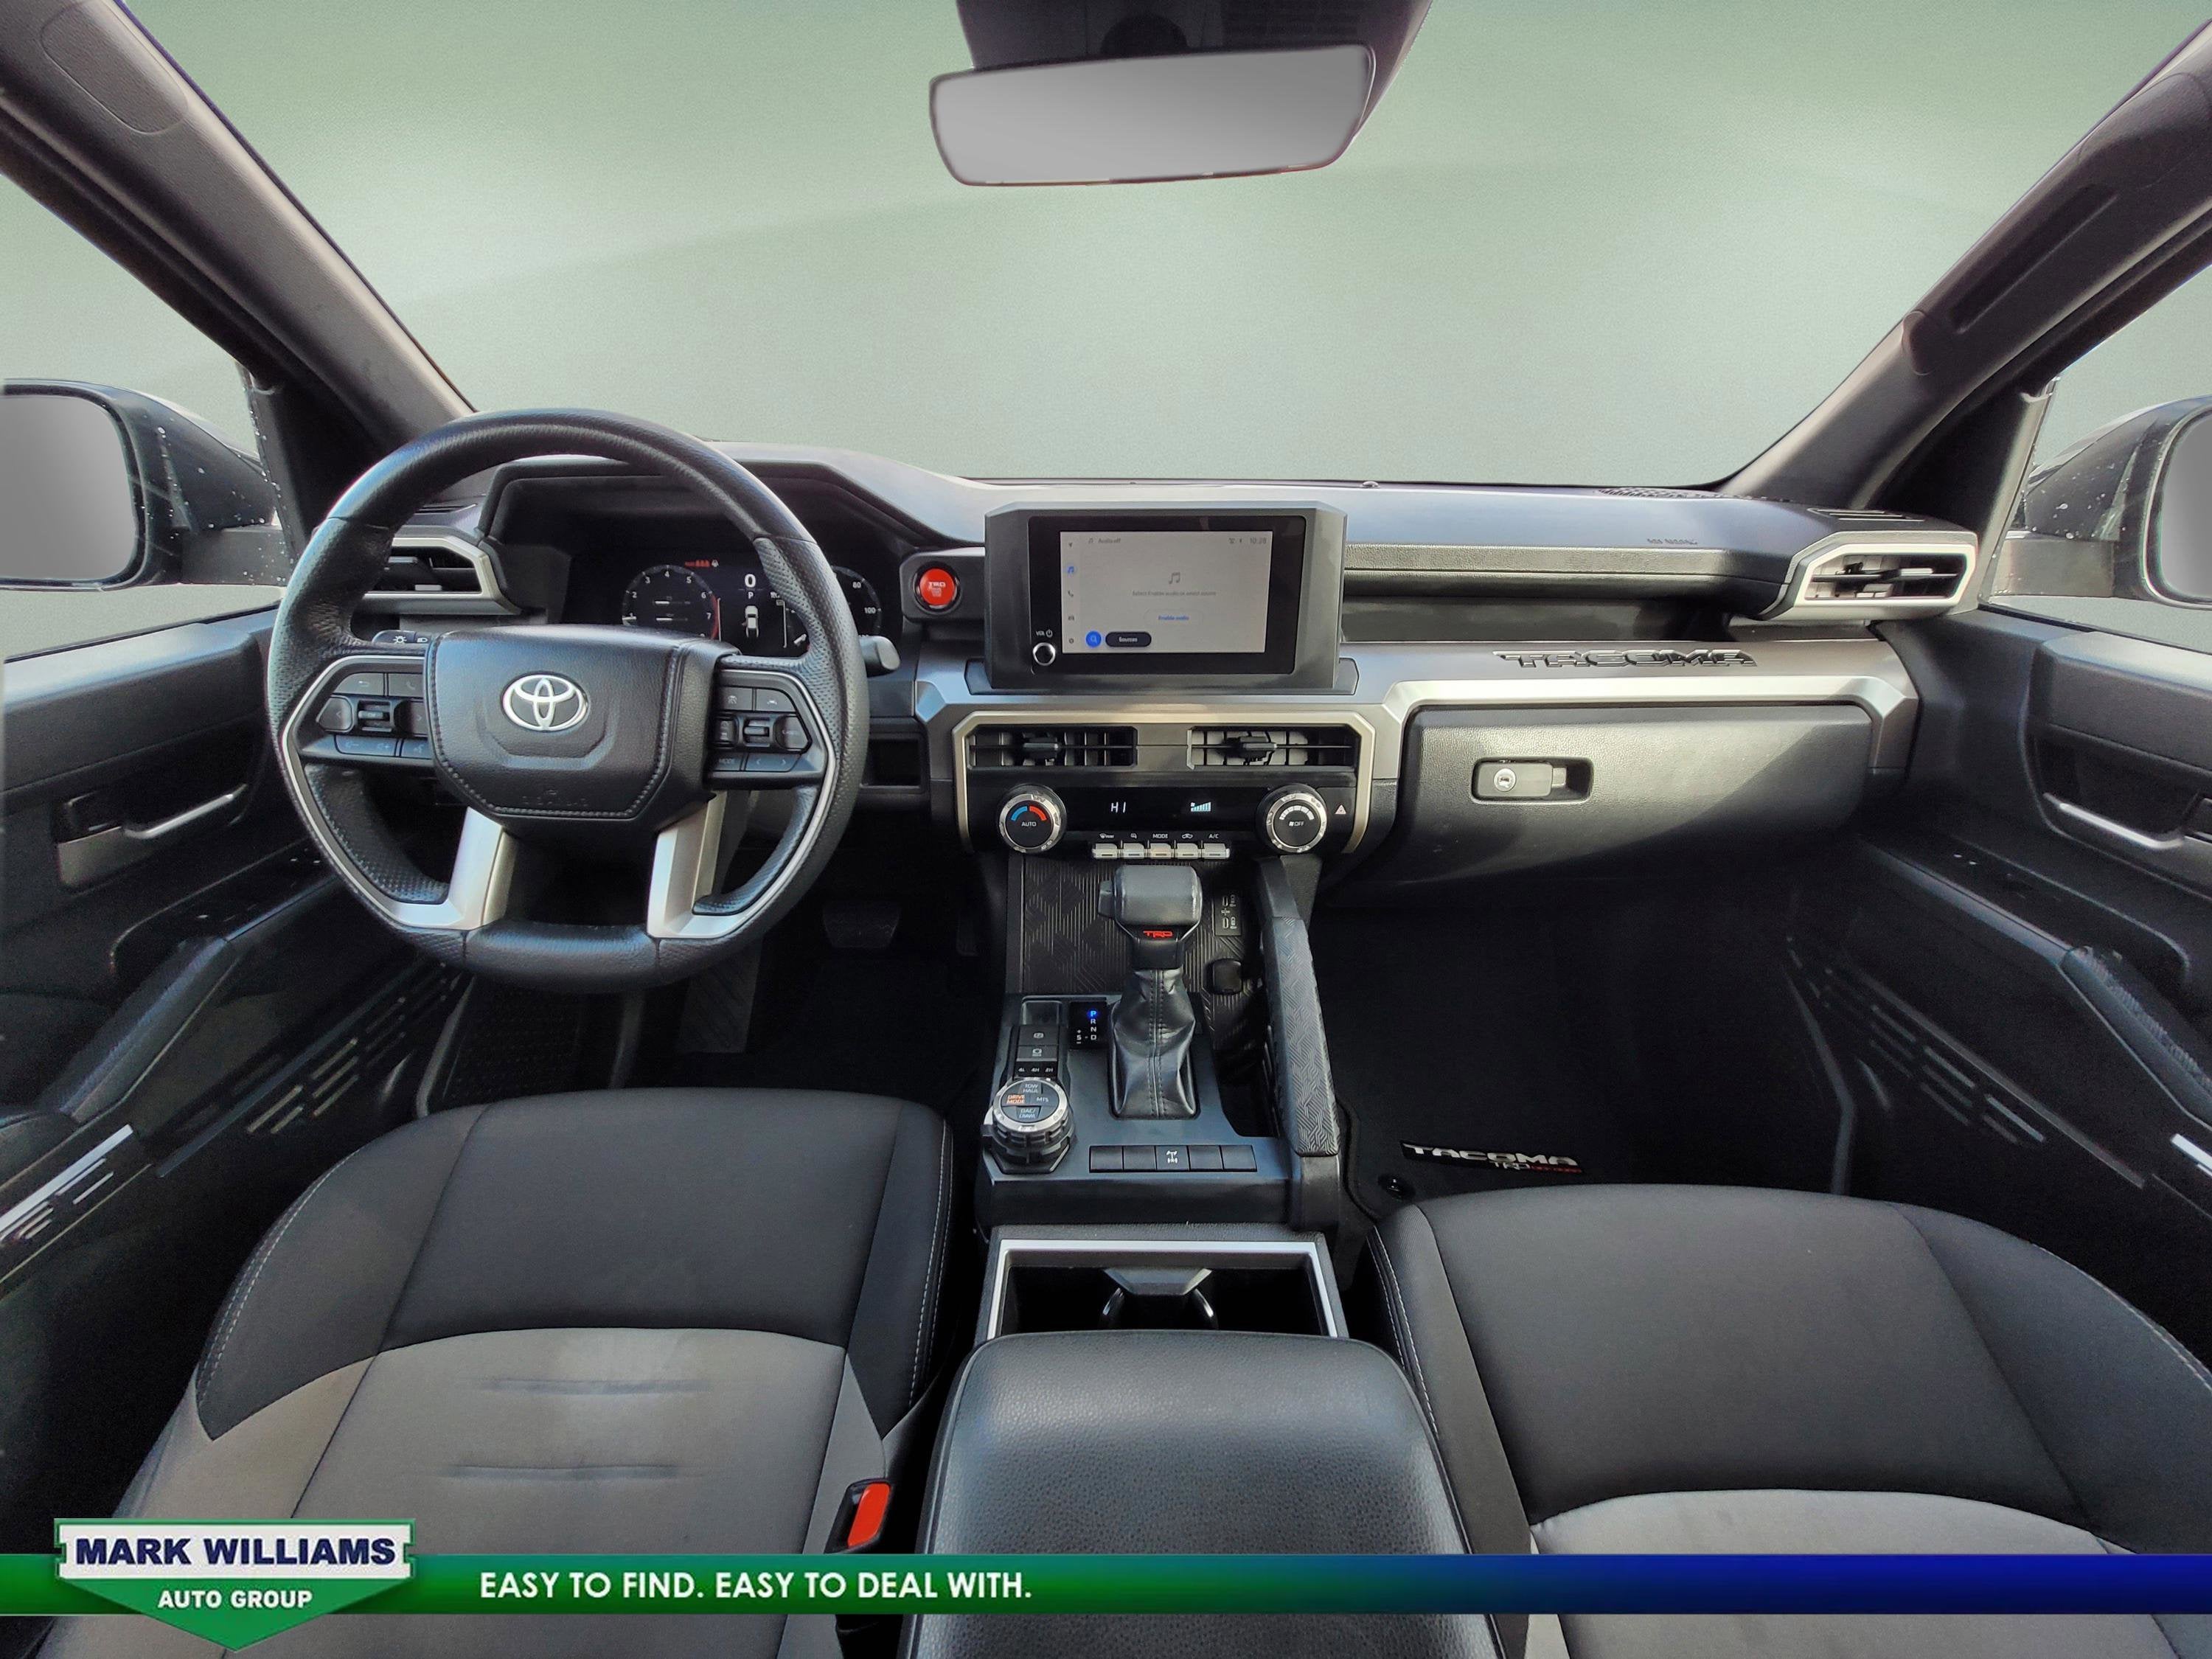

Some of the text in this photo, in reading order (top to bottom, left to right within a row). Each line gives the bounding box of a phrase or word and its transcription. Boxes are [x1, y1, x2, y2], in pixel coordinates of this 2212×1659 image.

[744, 574, 757, 588] 0
[1492, 650, 1758, 667] TACOMA
[1402, 1144, 1578, 1166] TACOMA
